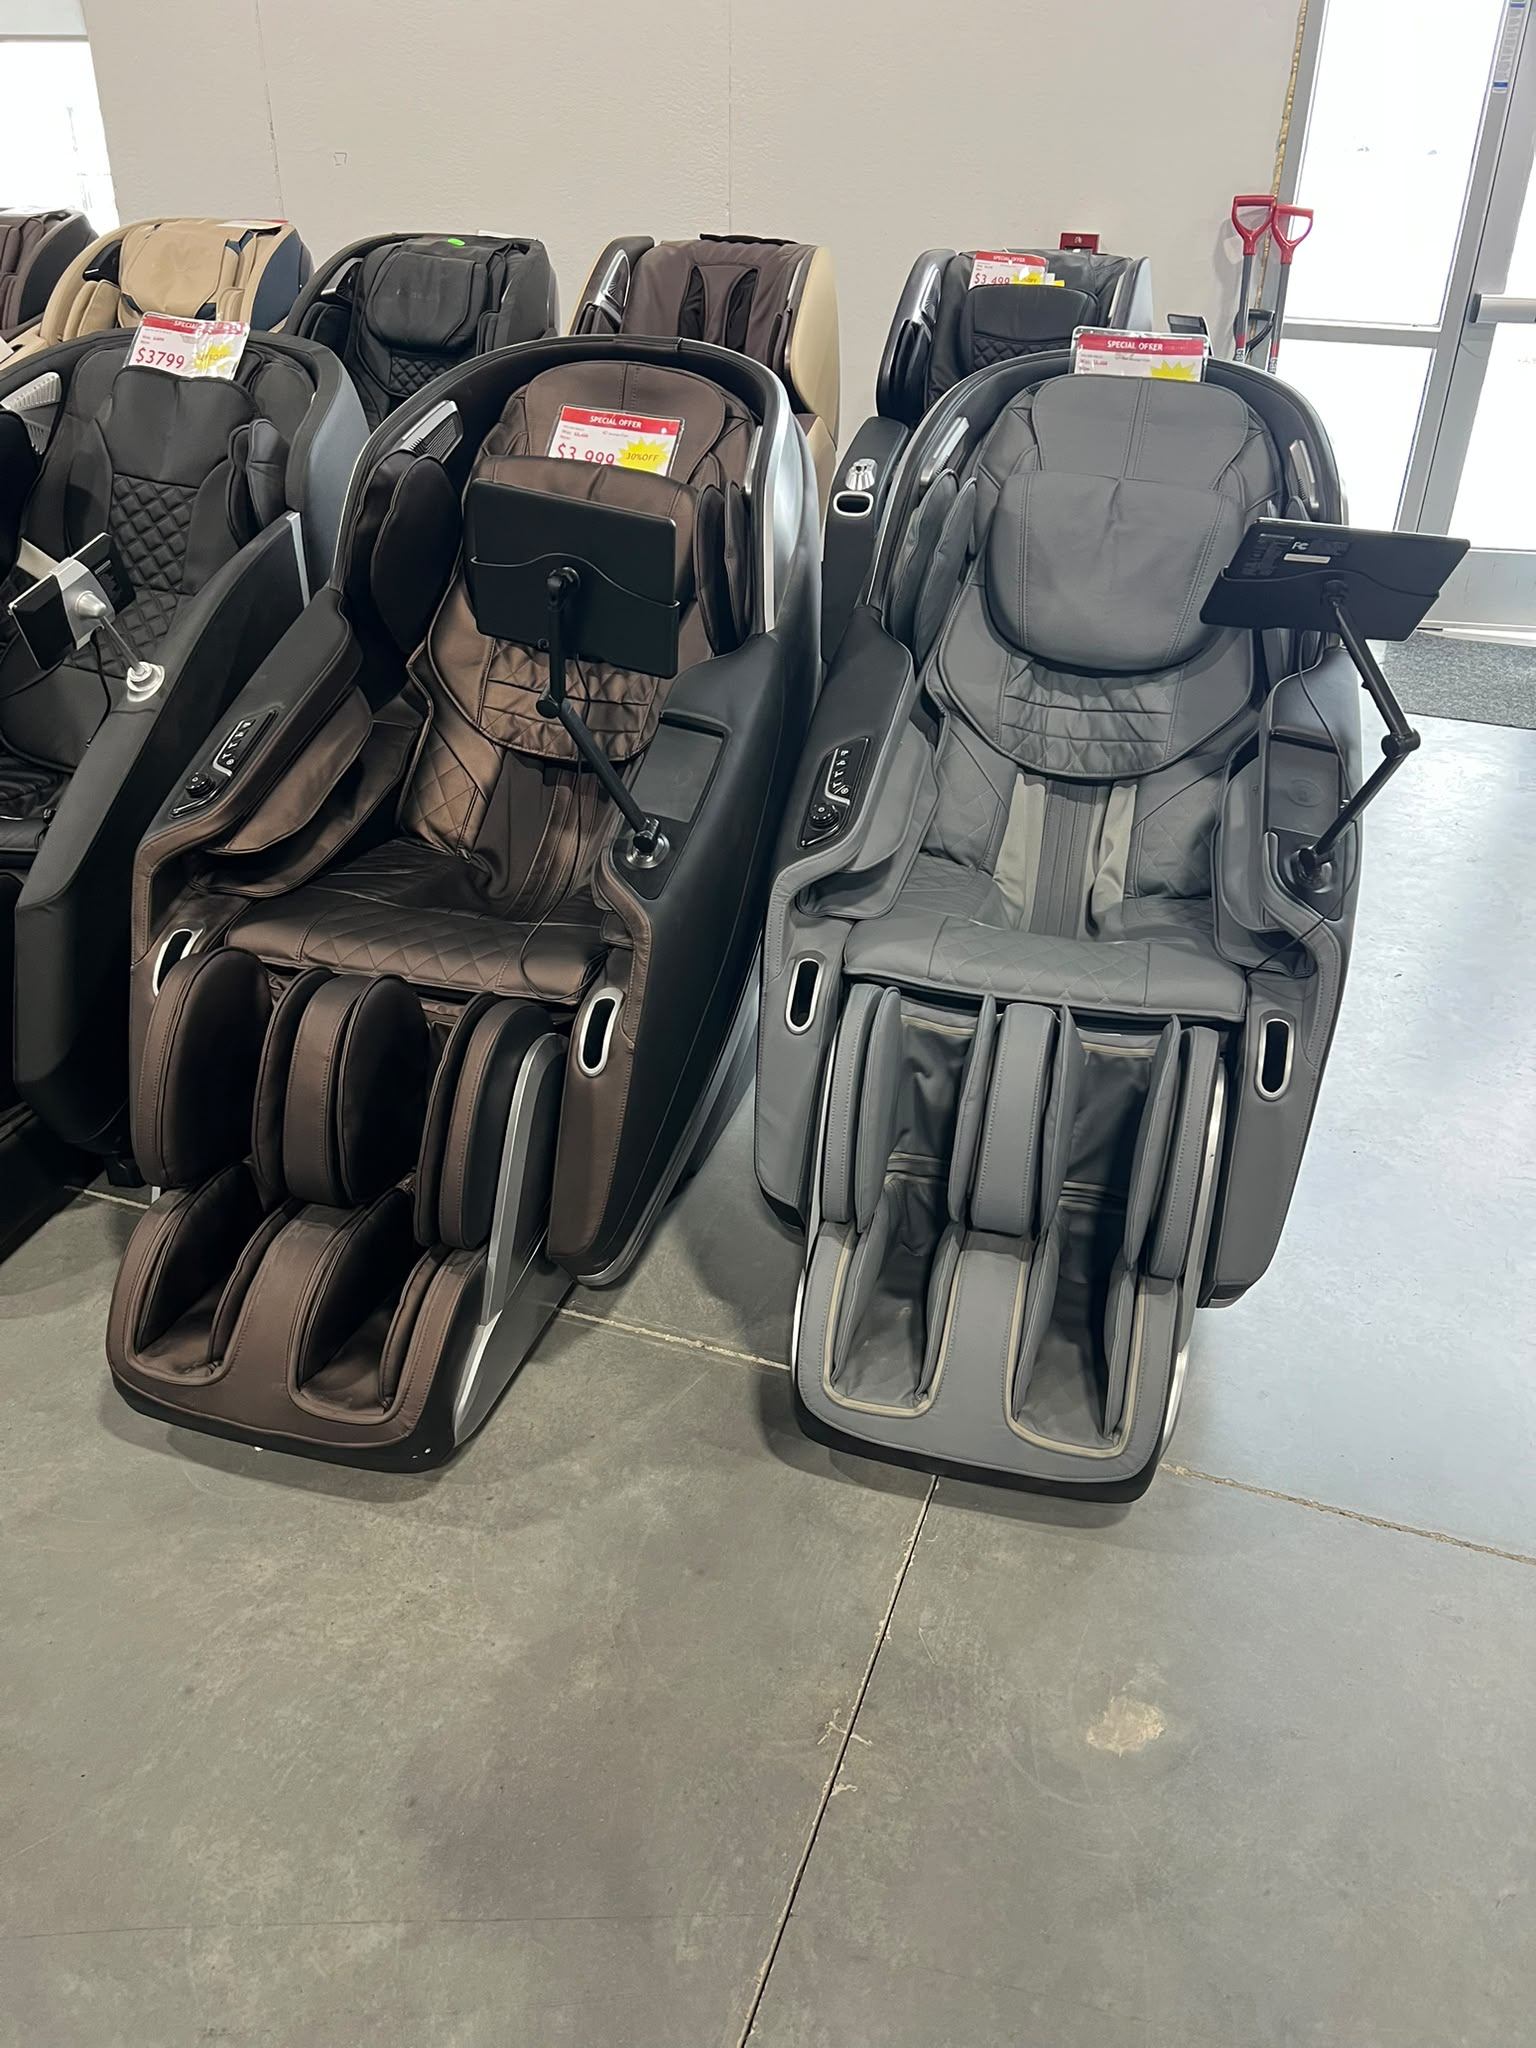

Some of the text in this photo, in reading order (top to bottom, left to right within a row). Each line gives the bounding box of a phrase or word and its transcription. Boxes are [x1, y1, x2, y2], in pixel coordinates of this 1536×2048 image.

[1107, 340, 1136, 349] SPECIAL
[136, 347, 184, 369] $3799
[590, 415, 642, 428] SPECIAL OFFER
